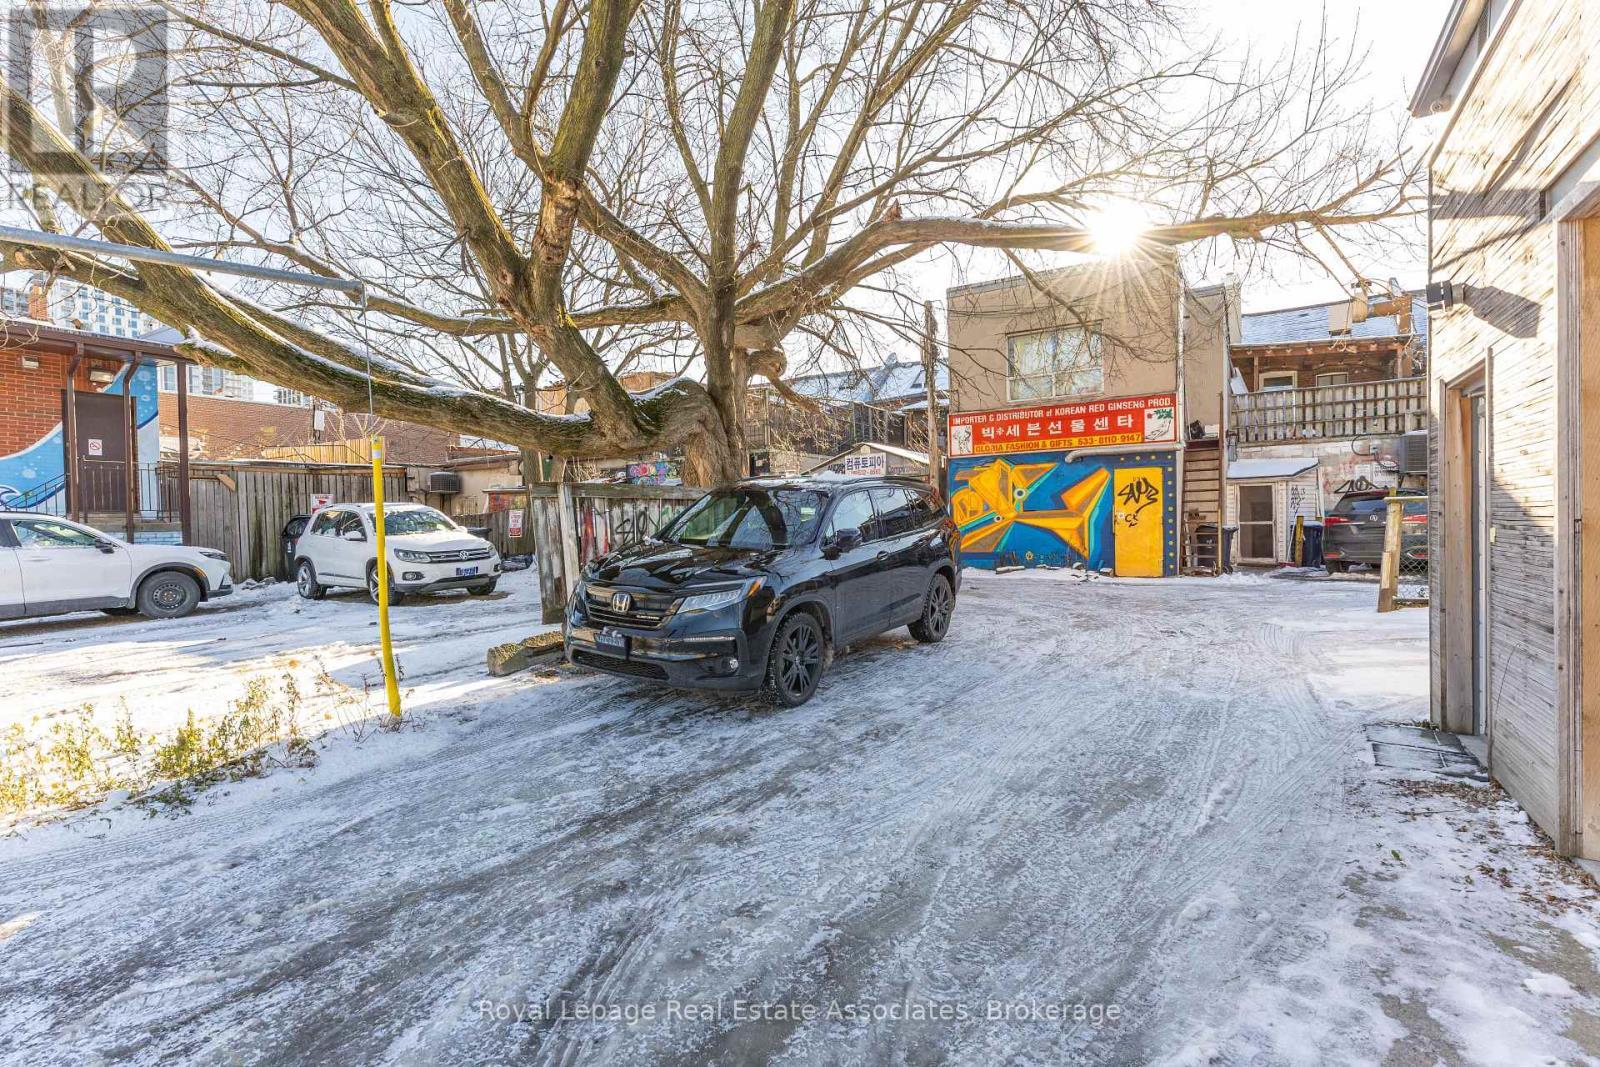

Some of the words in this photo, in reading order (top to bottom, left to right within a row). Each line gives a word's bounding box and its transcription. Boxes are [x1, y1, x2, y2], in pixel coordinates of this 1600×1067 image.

[952, 415, 987, 425] IMPORTER
[989, 413, 995, 422] &
[996, 410, 1044, 421] DISTRIBUTOR
[1055, 405, 1086, 416] KOREAN
[1089, 404, 1105, 413] RED
[1108, 400, 1145, 411] GINSENG
[1148, 397, 1174, 407] PROD.
[1006, 441, 1039, 451] FASHION
[1050, 439, 1073, 448] GIFTS
